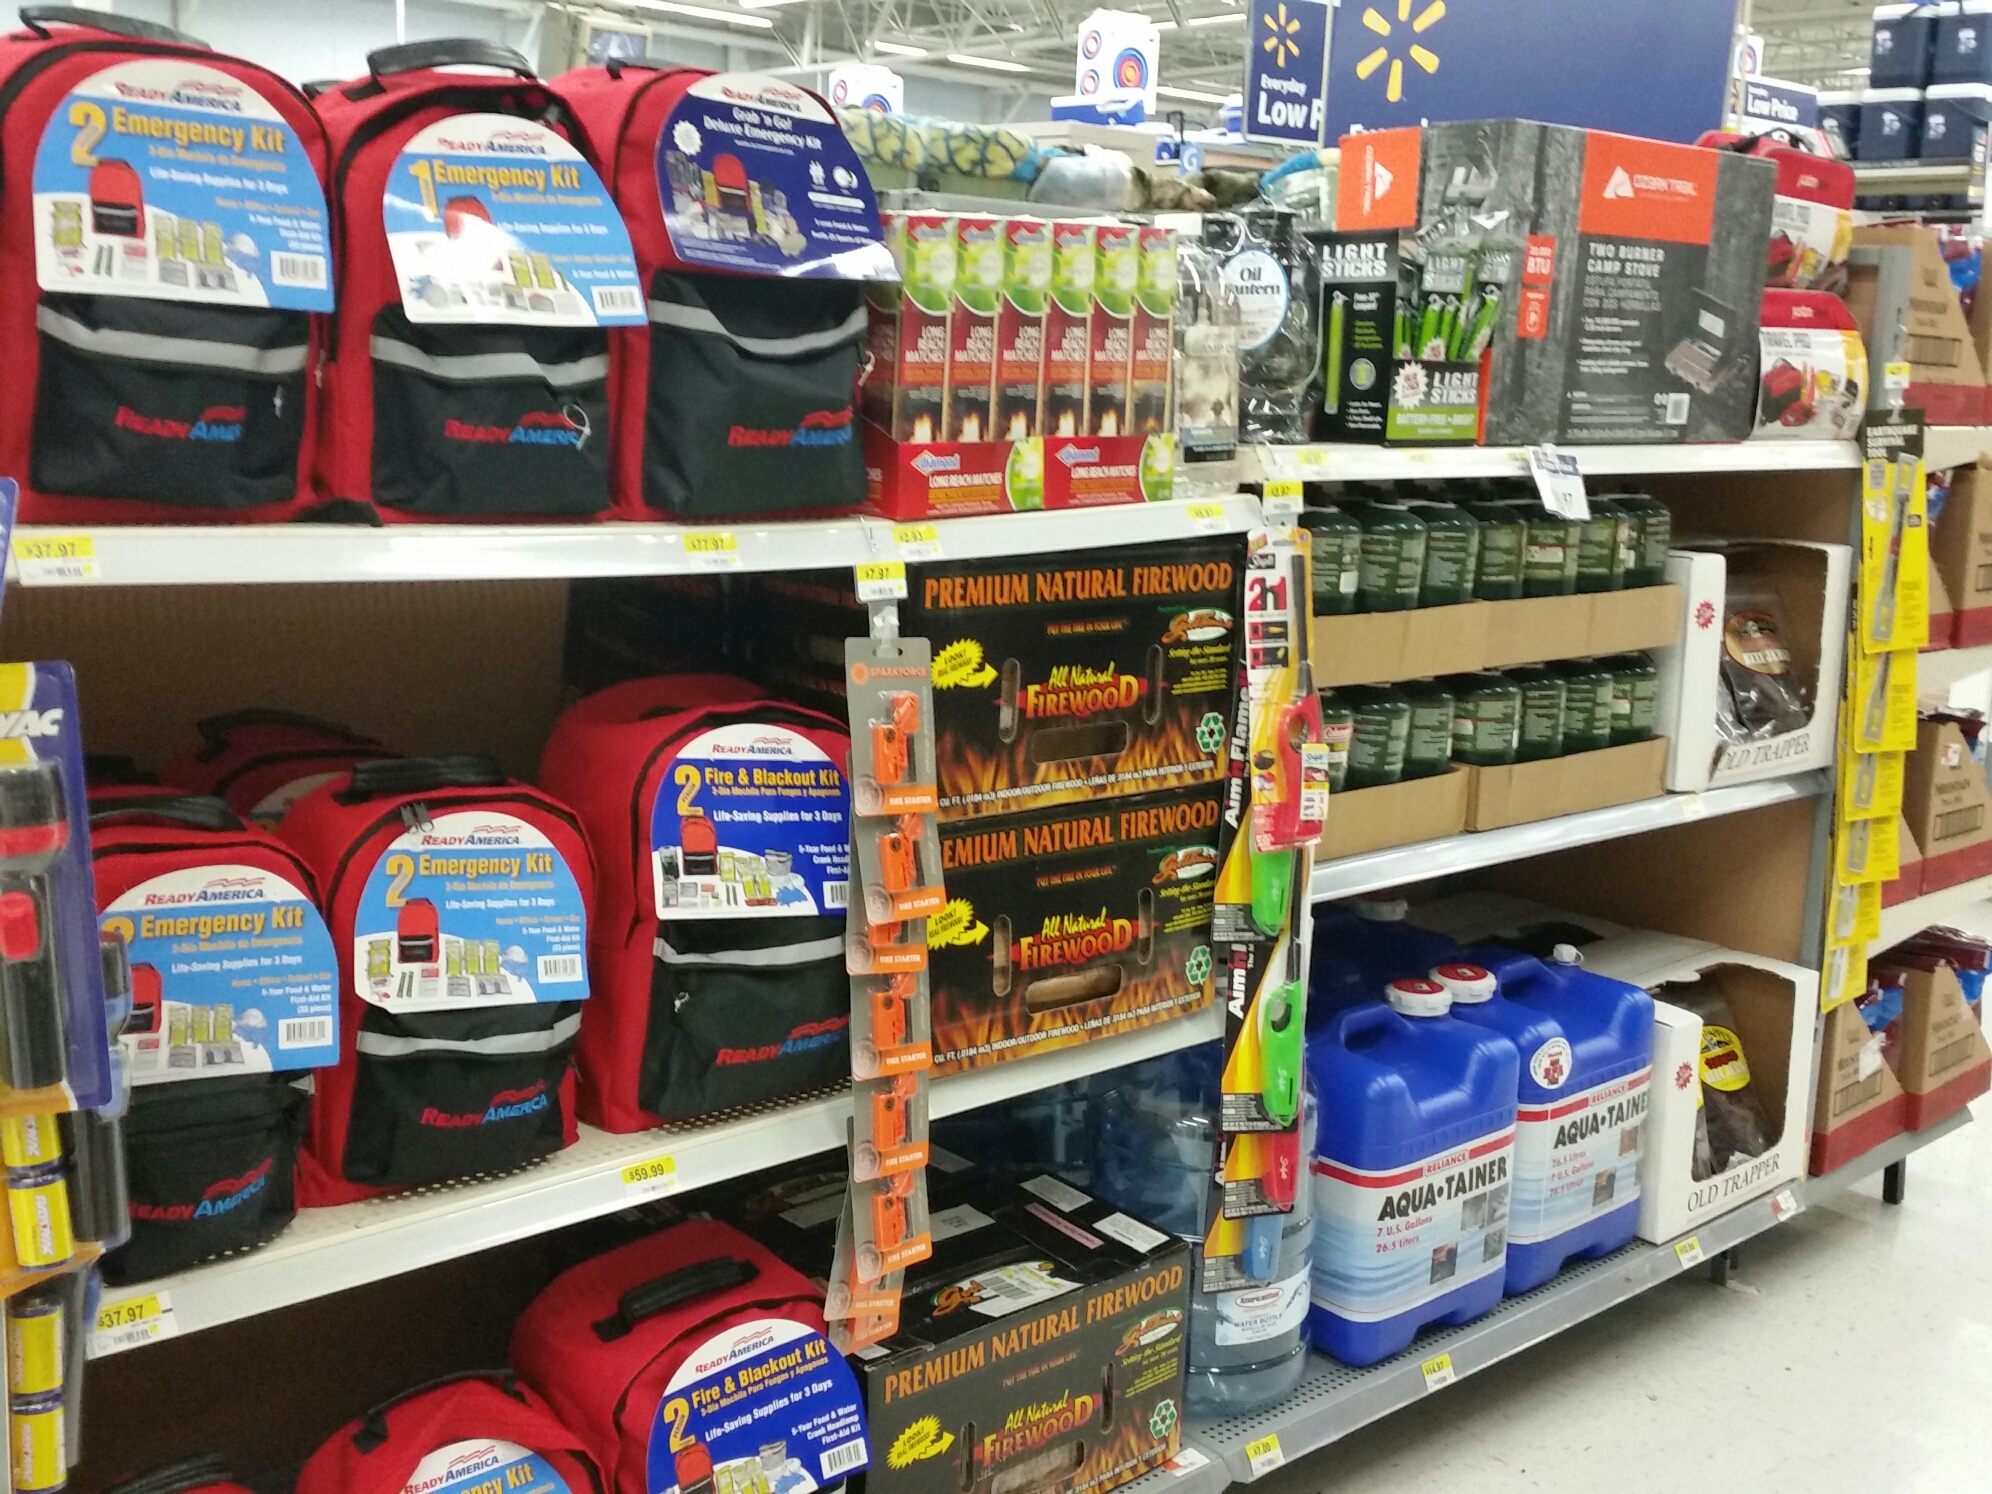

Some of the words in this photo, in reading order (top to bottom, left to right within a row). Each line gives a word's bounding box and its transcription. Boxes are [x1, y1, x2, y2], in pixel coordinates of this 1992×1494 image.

[1261, 74, 1307, 97] Everyday
[1258, 91, 1308, 129] Low
[68, 101, 107, 167] 2
[112, 107, 246, 152] Emergency
[251, 125, 285, 153] Kit
[408, 160, 439, 218] 1
[434, 159, 547, 191] Emergency
[552, 164, 581, 189] Kit
[1322, 243, 1388, 261] LIGHT
[1589, 242, 1616, 258] TWO
[1618, 245, 1665, 263] BURNER
[1240, 267, 1262, 282] Oil
[1321, 260, 1388, 278] STICKS
[1527, 257, 1551, 275] BTU
[1587, 259, 1622, 275] CAMP
[1624, 262, 1661, 278] STOVE
[1433, 371, 1479, 388] LIGHT
[924, 573, 1029, 610] PREMIUM
[1035, 567, 1127, 601] NATURAL
[1133, 562, 1234, 594] FIREWOOD
[1049, 663, 1069, 690] All
[1070, 661, 1115, 686] Natural
[1025, 674, 1139, 719] FIREWOOD
[674, 765, 704, 816] 2
[705, 767, 734, 785] Fire
[738, 769, 750, 785] &
[752, 767, 816, 786] Blackout
[819, 769, 840, 786] Kit
[904, 795, 932, 805] STARTER
[713, 810, 761, 824] Life-Saving
[763, 810, 799, 824] Supplies
[801, 810, 813, 821] for
[815, 811, 821, 821] 3
[822, 810, 843, 824] Days
[943, 830, 1017, 869] EMIUM
[1023, 815, 1114, 854] NATURAL
[1120, 800, 1219, 840] FIREWOOD
[385, 854, 416, 909] 2
[418, 855, 521, 879] Emergency
[526, 853, 553, 873] Kit
[140, 911, 265, 939] Emergency
[272, 906, 304, 929] Kit
[934, 908, 957, 926] LOOK!
[1041, 915, 1063, 937] All
[1062, 906, 1108, 935] Natural
[1019, 917, 1133, 971] FIREWOOD
[894, 953, 921, 963] STARTER
[991, 1030, 1046, 1052] INDOOR/OUTDOOR
[1048, 1024, 1080, 1038] FIREWOOD
[1592, 1083, 1626, 1104] RELIANCE
[629, 1163, 665, 1183] $59.99
[1427, 1152, 1467, 1174] RELIANCE
[1688, 1183, 1718, 1212] OLD
[1722, 1152, 1781, 1197] TRAPPER
[1386, 1222, 1402, 1236] U.S.
[1404, 1214, 1433, 1232] Gallons
[1376, 1240, 1397, 1253] 26.5
[1398, 1234, 1420, 1248] Liters
[97, 1304, 144, 1329] $37.97
[885, 1342, 985, 1403] PREMIUM
[991, 1305, 1080, 1362] NATURAL
[1086, 1265, 1183, 1324] FIREWOOD
[663, 1397, 696, 1454] 2
[691, 1385, 721, 1410] Fire
[724, 1376, 736, 1393] &
[738, 1347, 802, 1387] Blackout
[805, 1338, 827, 1362] Kit
[704, 1413, 752, 1442] Life-Saving
[753, 1398, 789, 1420] Supplies
[790, 1388, 803, 1403] for
[804, 1386, 811, 1398] 3
[812, 1379, 833, 1395] Days
[813, 1413, 830, 1428] Food
[837, 1403, 857, 1418] Water
[1005, 1411, 1025, 1435] All
[1025, 1389, 1069, 1423] Natural
[806, 1428, 826, 1441] Crank
[826, 1415, 860, 1434] Headlamp
[822, 1427, 850, 1446] First-Aid
[851, 1423, 862, 1436] Kit
[902, 1426, 925, 1447] LOOK!
[982, 1395, 1095, 1467] FIREWOOD
[505, 1462, 534, 1490] Kit
